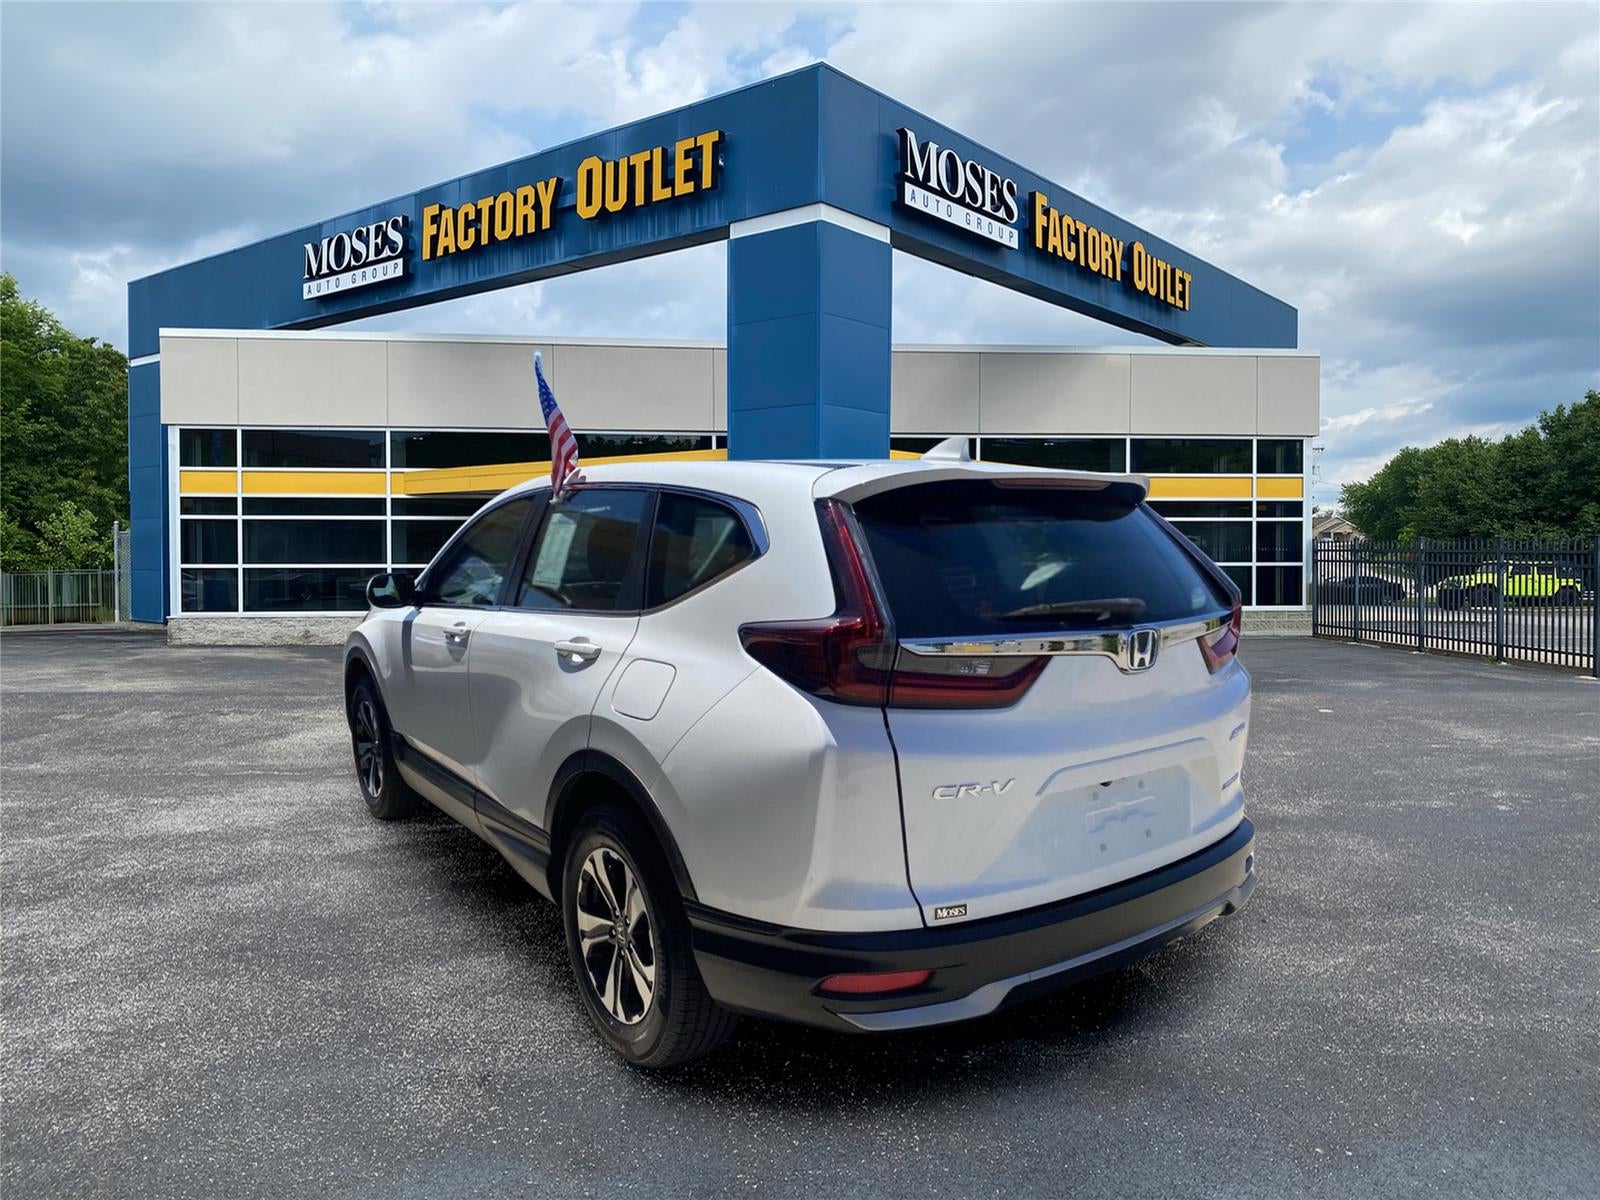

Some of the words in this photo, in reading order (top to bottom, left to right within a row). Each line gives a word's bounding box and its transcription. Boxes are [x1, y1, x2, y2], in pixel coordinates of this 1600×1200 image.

[422, 177, 559, 261] FACTORY
[576, 130, 720, 220] OUTLET
[903, 128, 1018, 224] MOSES
[303, 215, 404, 279] MOSES
[910, 189, 953, 218] AUTO
[965, 212, 1015, 243] GROUP
[307, 276, 341, 296] AUTO
[351, 261, 400, 285] GROUP
[1034, 190, 1124, 282] FACTORY
[1132, 240, 1192, 311] OUTLET
[932, 778, 1016, 800] CR-V
